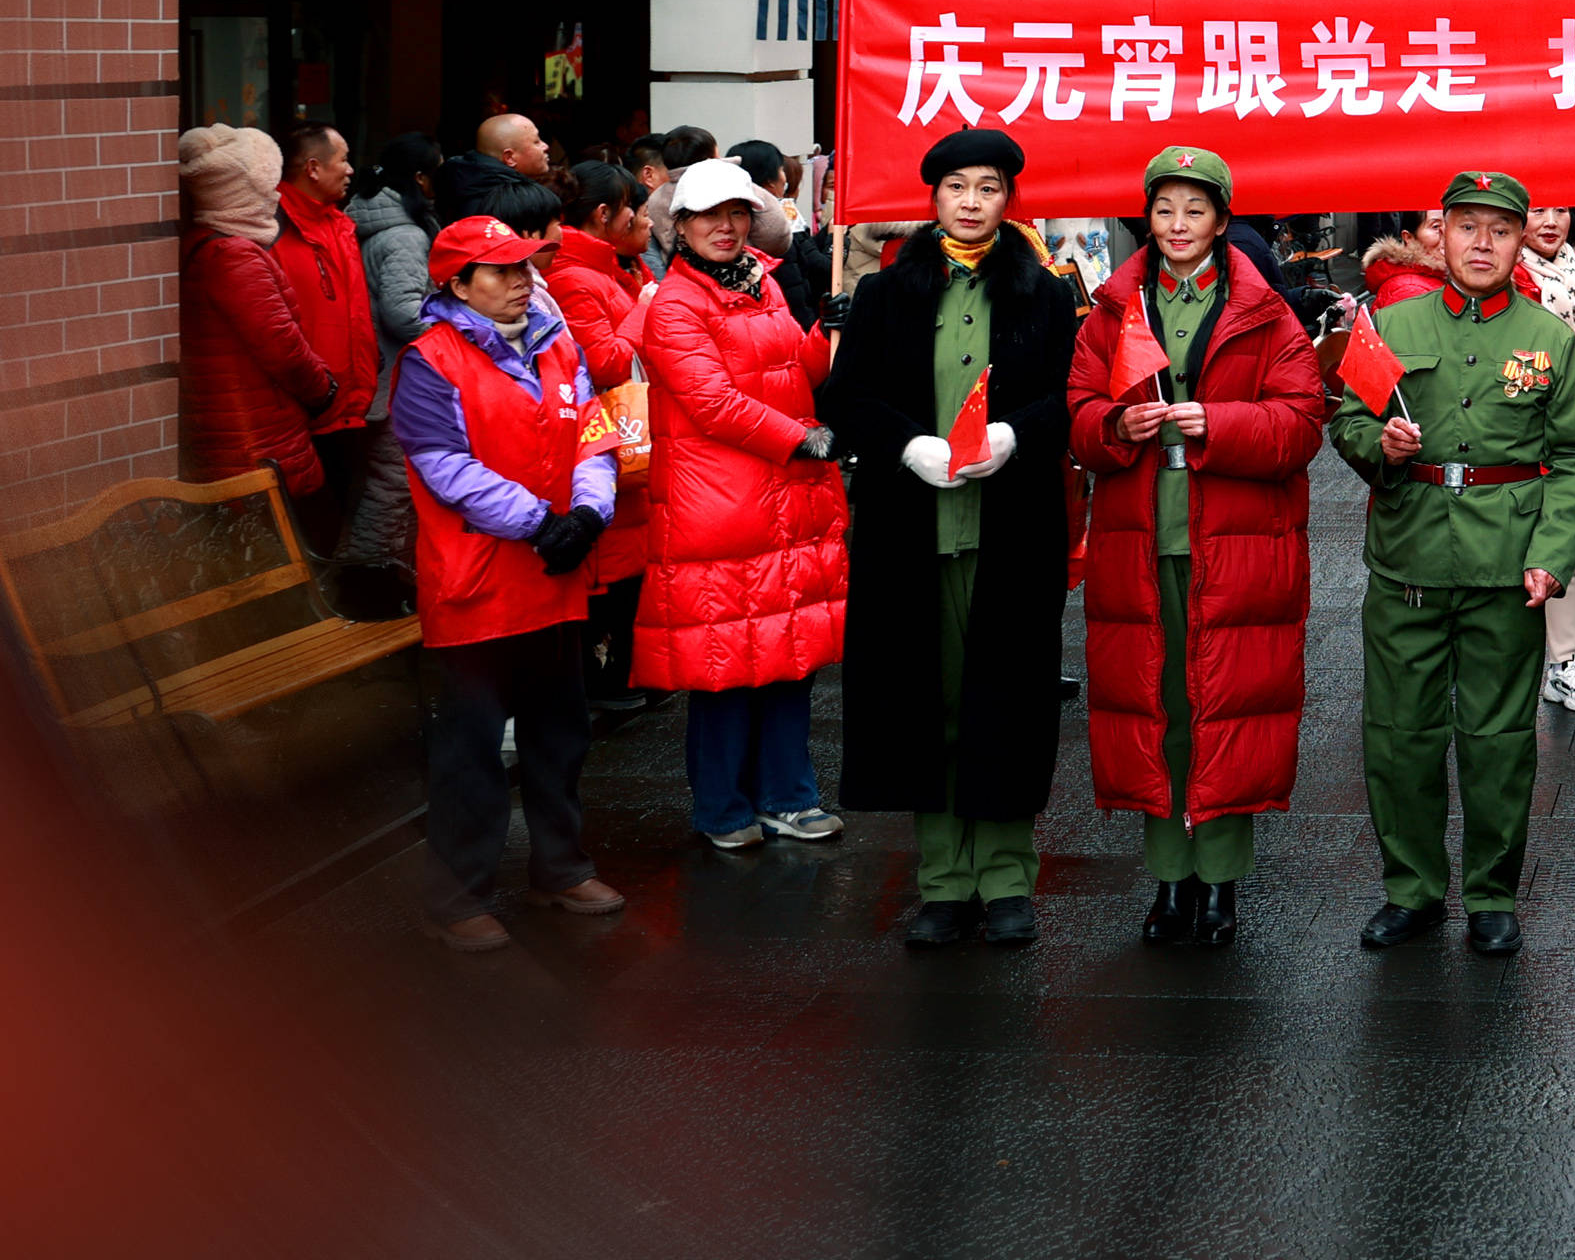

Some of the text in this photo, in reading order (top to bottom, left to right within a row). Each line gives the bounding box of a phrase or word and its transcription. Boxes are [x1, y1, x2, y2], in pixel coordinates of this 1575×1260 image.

[896, 12, 1487, 127] 庆元宵跟党走
